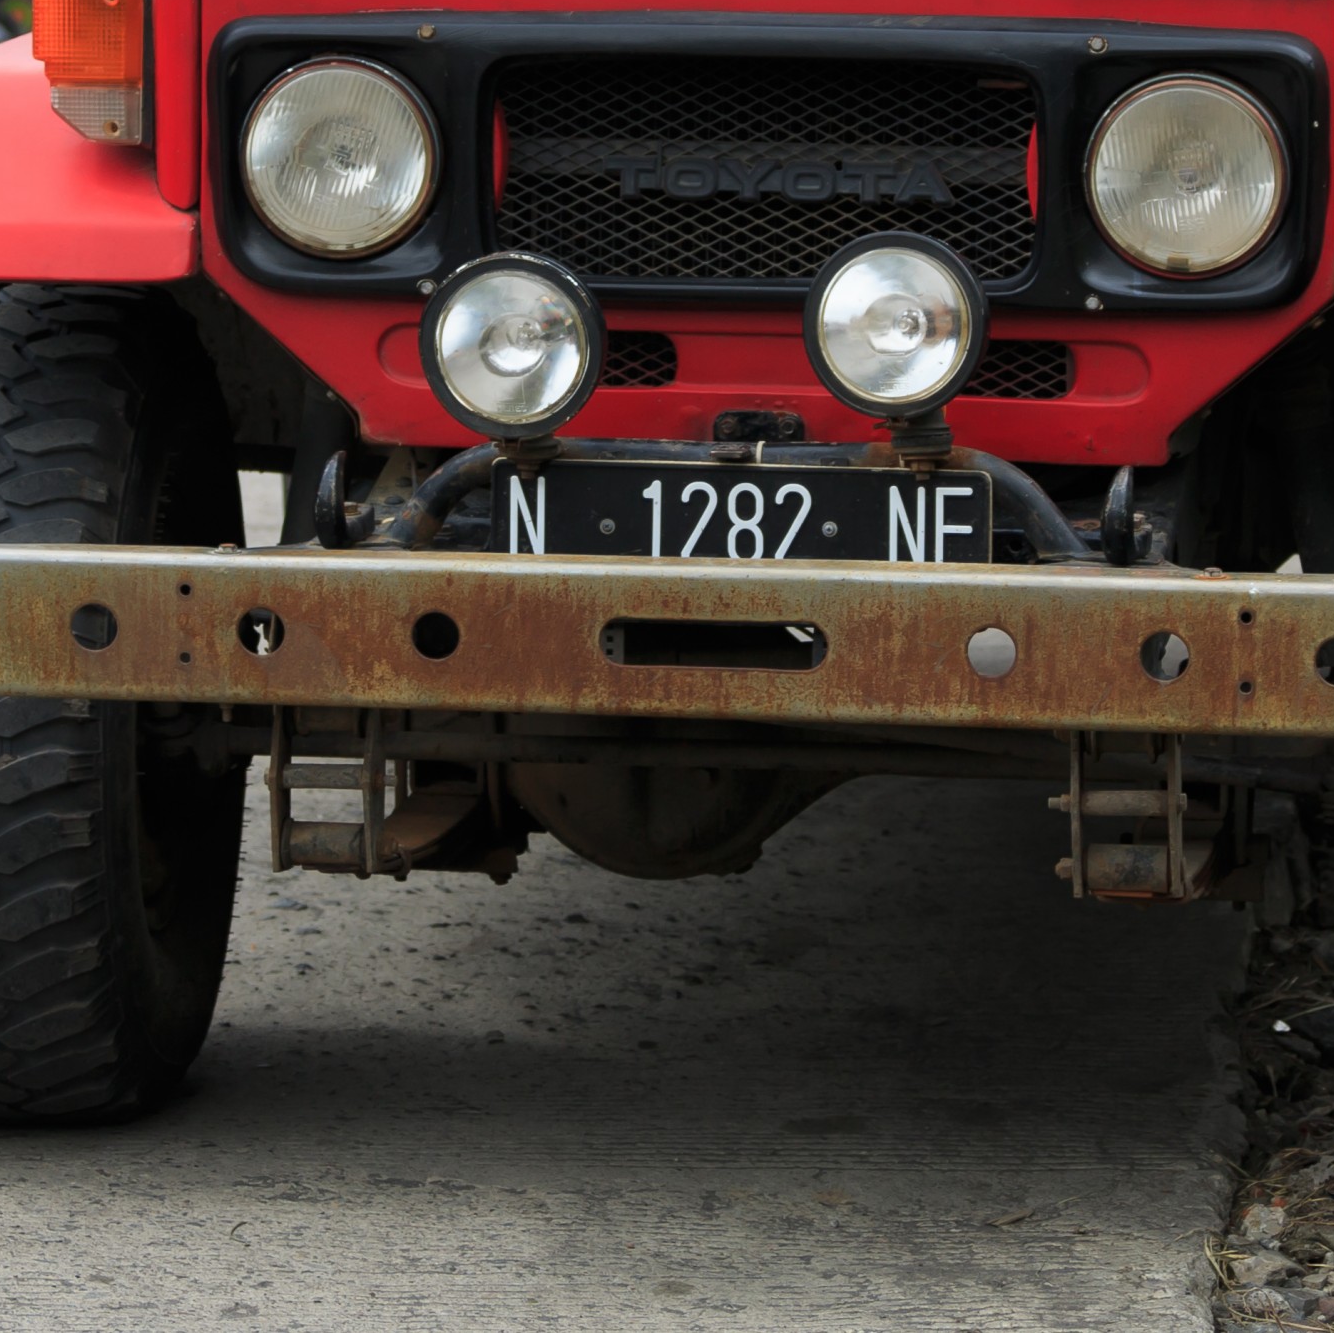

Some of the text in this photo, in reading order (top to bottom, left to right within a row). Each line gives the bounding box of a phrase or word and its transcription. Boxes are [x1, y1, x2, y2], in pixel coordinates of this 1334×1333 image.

[605, 155, 956, 208] TOYOTA
[509, 475, 546, 555] N
[642, 479, 814, 560] 1282
